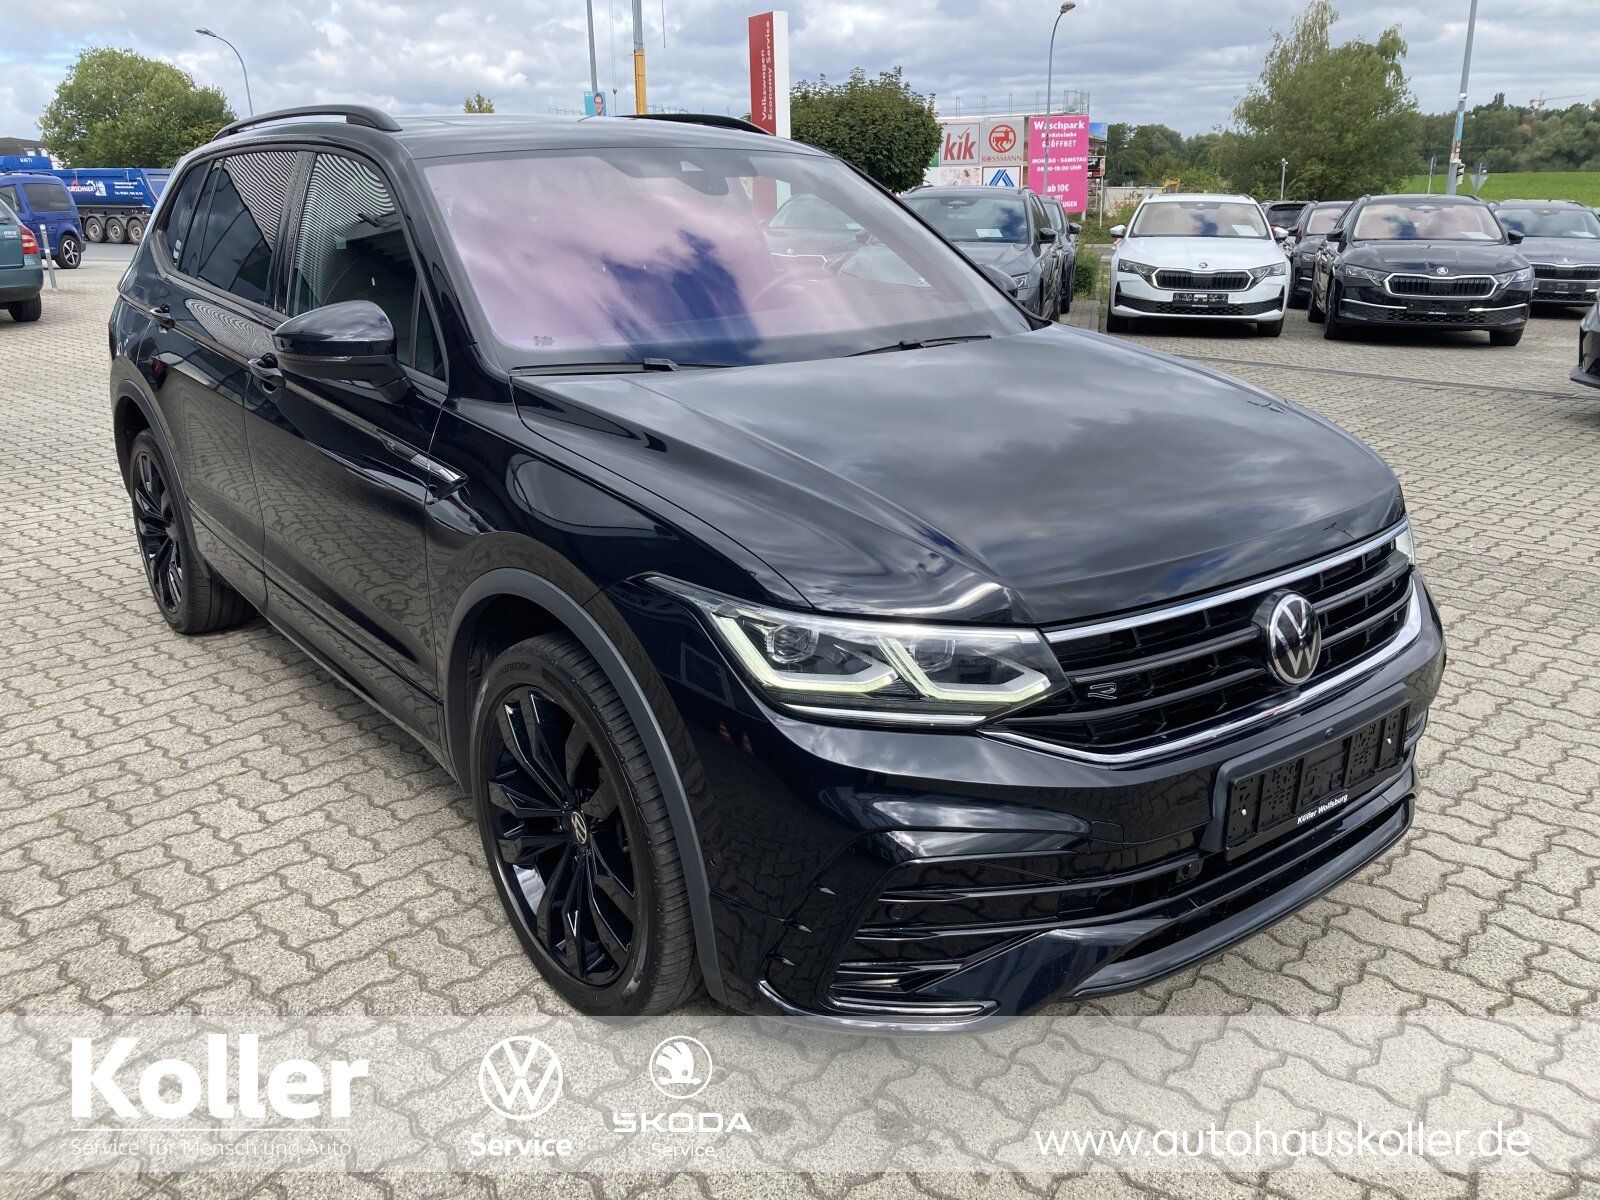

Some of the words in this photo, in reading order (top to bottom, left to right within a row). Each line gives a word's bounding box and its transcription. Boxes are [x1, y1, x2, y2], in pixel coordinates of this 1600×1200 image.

[982, 155, 1022, 163] ROSSMANN
[1032, 156, 1057, 164] MONAG
[1047, 184, 1056, 192] ab
[1057, 183, 1070, 192] 10€
